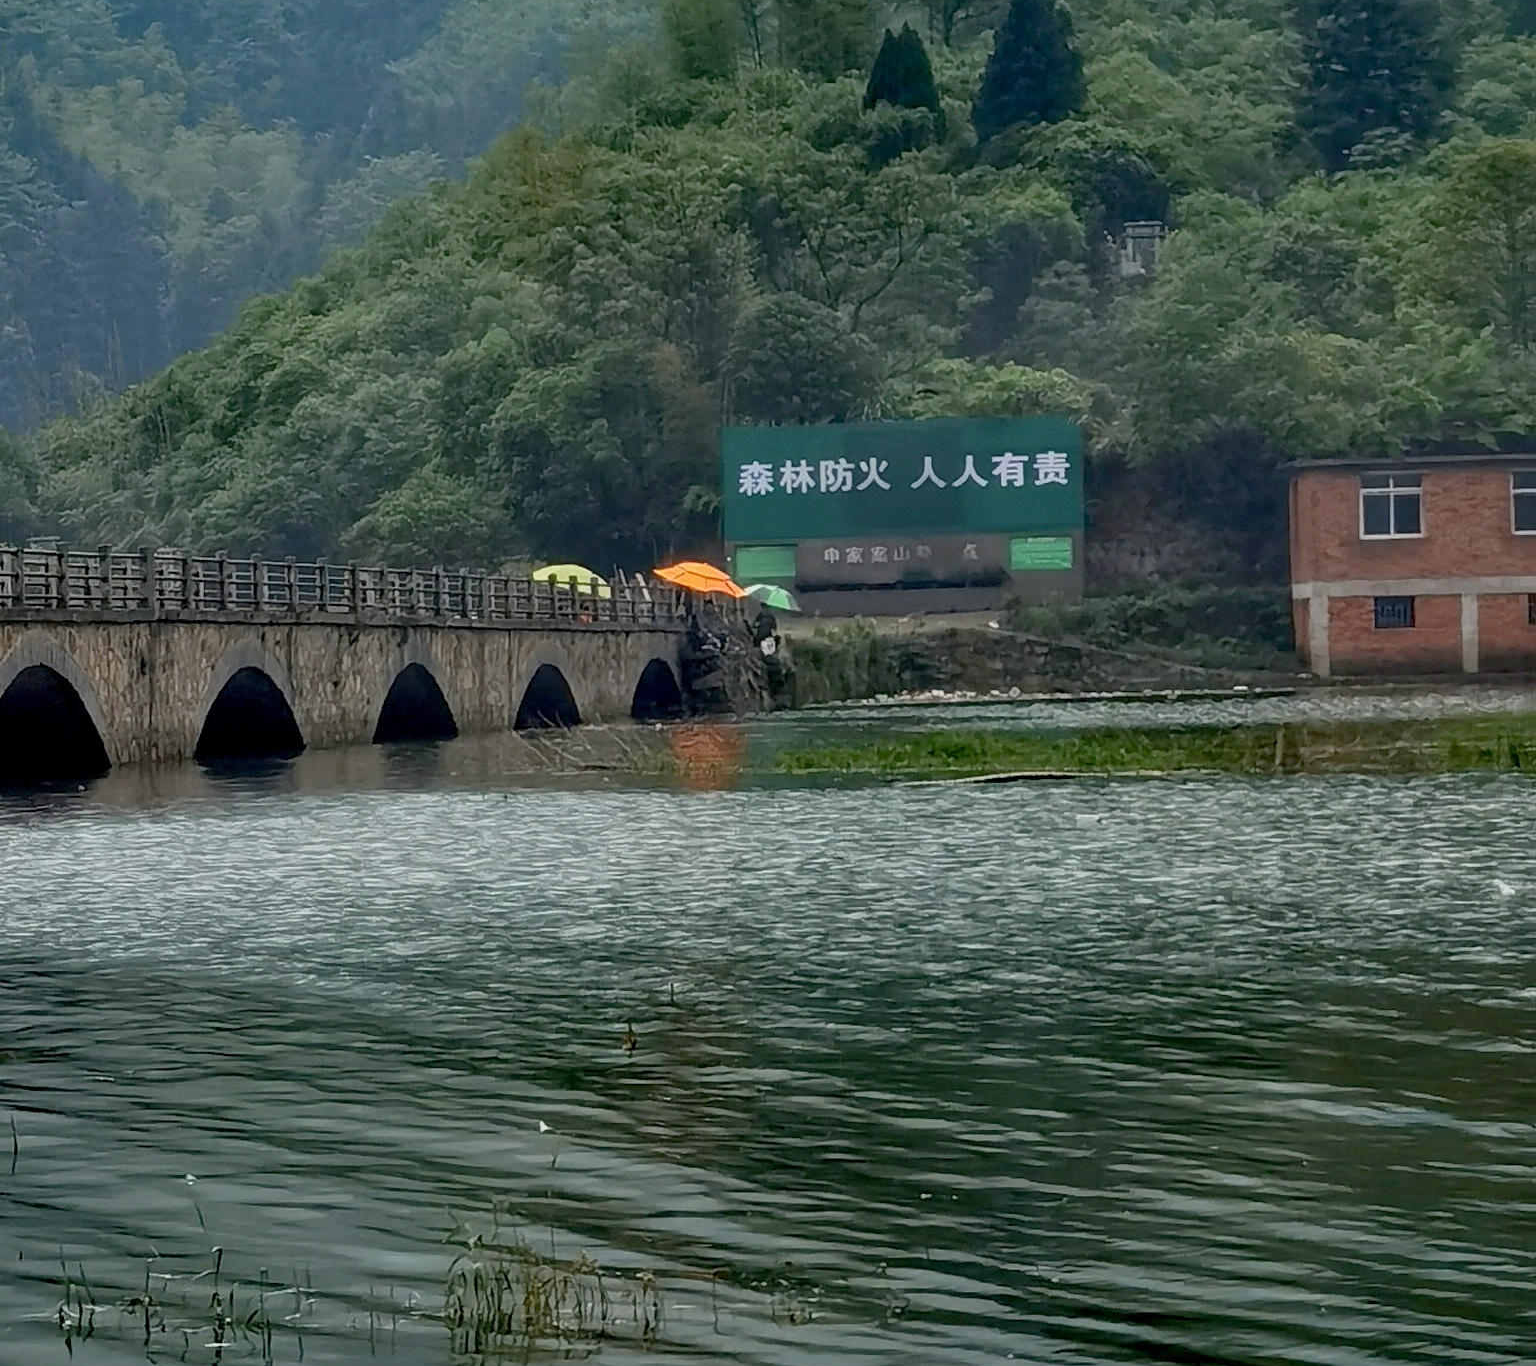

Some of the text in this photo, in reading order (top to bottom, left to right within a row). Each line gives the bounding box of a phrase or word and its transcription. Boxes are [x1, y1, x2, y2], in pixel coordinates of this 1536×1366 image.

[738, 451, 1071, 496] 森林防火 人人有责
